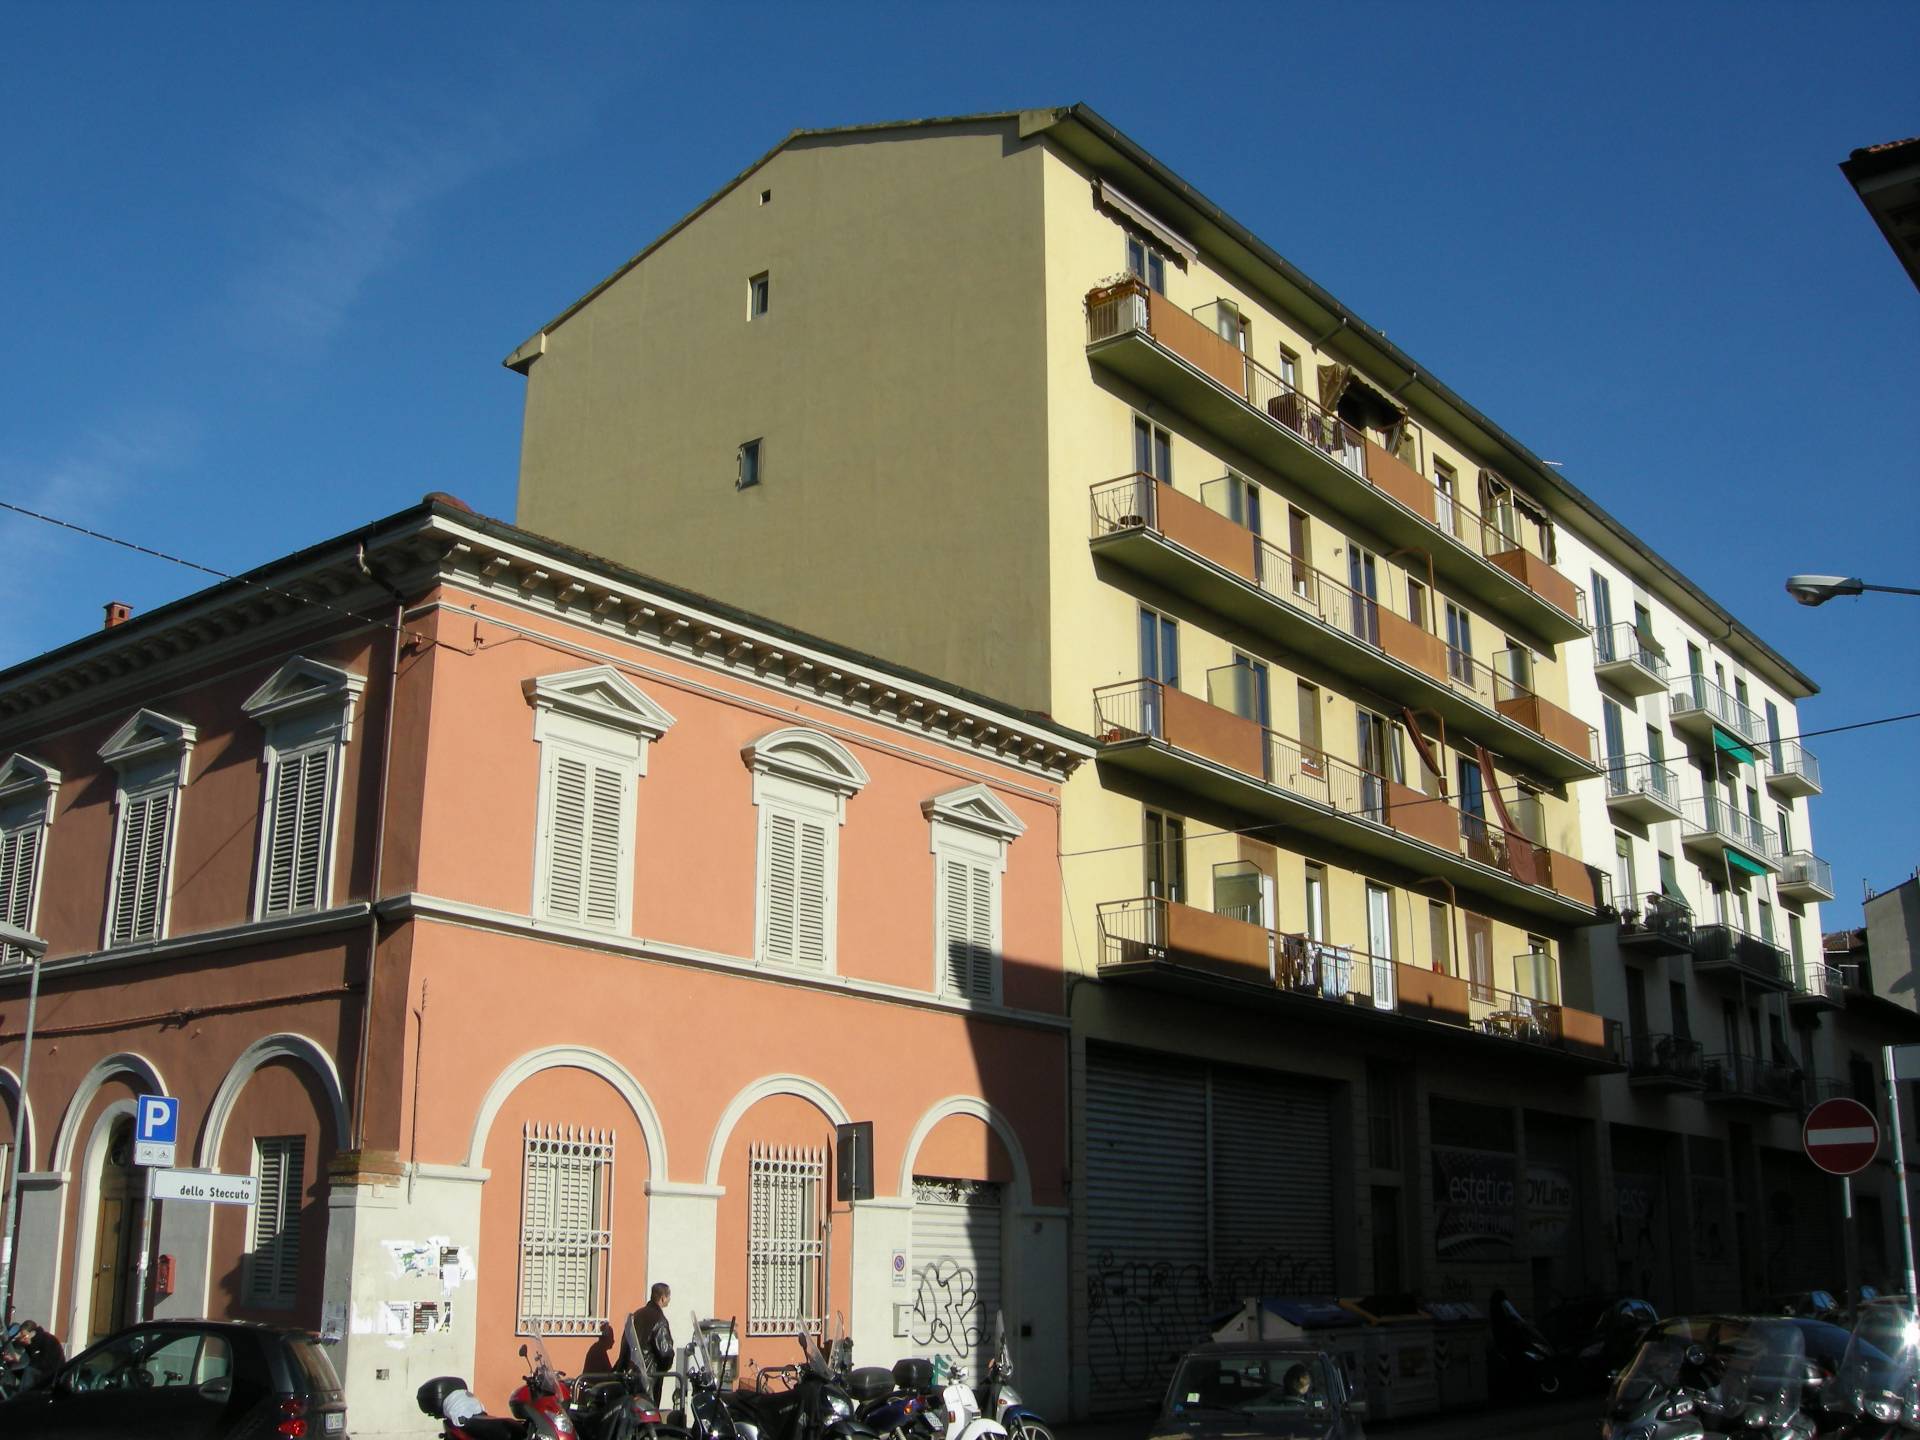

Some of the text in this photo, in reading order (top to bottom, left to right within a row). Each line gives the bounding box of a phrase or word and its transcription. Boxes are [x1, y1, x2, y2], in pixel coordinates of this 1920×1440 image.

[144, 1100, 171, 1137] P
[180, 1185, 250, 1200] dello Steccuto
[1449, 1171, 1514, 1207] estetica
